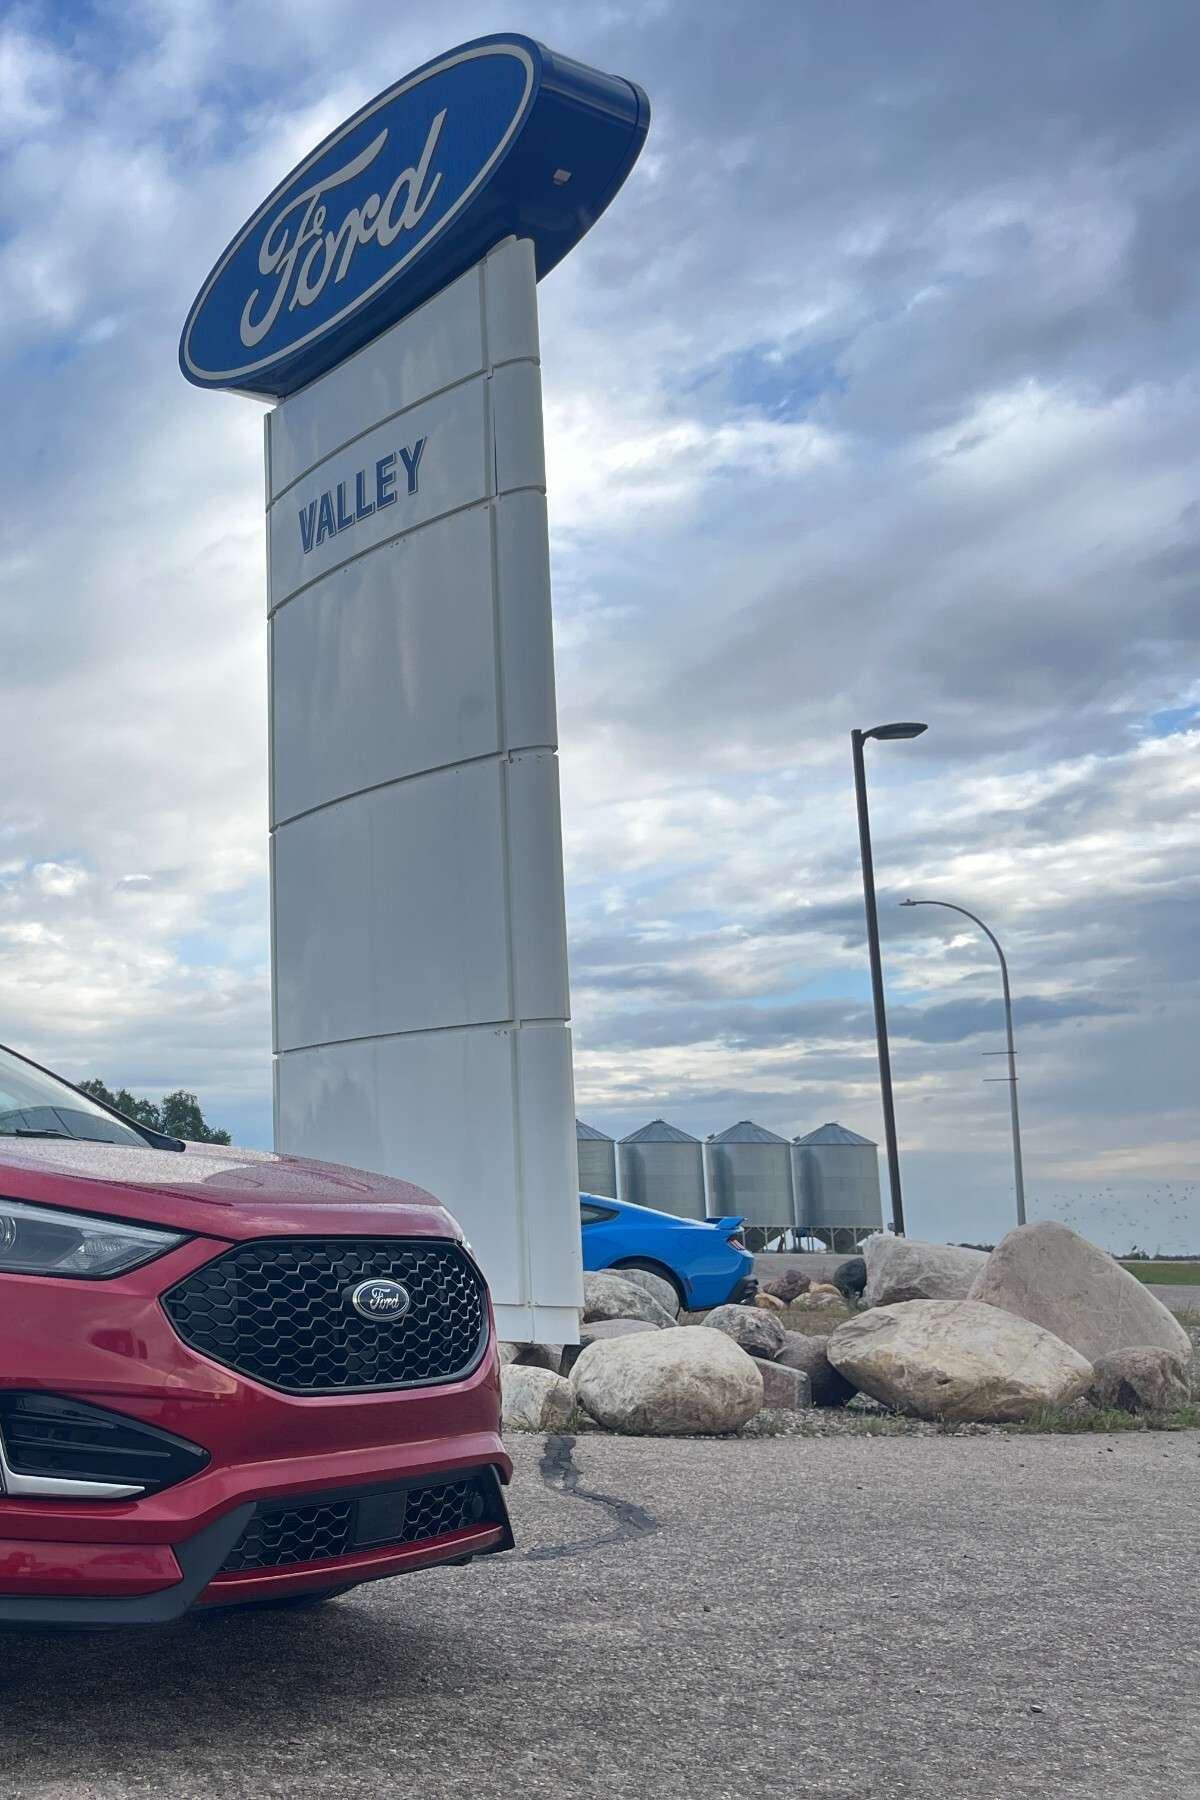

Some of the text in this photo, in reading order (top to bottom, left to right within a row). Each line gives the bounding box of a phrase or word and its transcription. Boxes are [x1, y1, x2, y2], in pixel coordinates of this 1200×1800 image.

[240, 108, 447, 346] Ford
[299, 436, 428, 554] VALLEY
[369, 1287, 400, 1310] Ford
